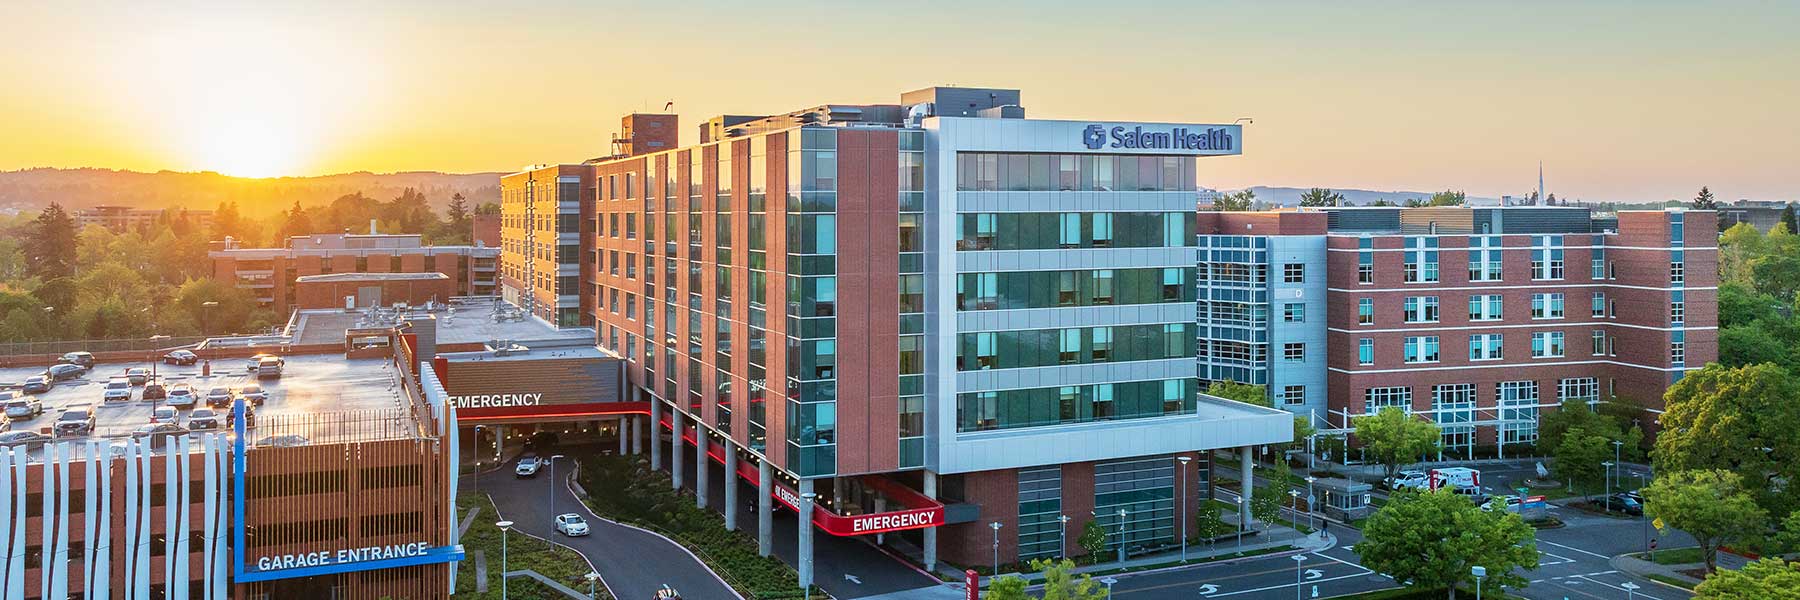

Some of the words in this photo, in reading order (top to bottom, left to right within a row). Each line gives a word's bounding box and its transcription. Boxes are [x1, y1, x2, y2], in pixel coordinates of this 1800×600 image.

[1111, 126, 1170, 149] Salem
[1173, 127, 1233, 150] Health
[1295, 289, 1303, 298] D
[448, 393, 542, 409] EMERGENCY
[853, 511, 935, 532] EMERGENCY
[258, 551, 330, 571] GARAGE
[337, 541, 428, 564] ENTRANCE
